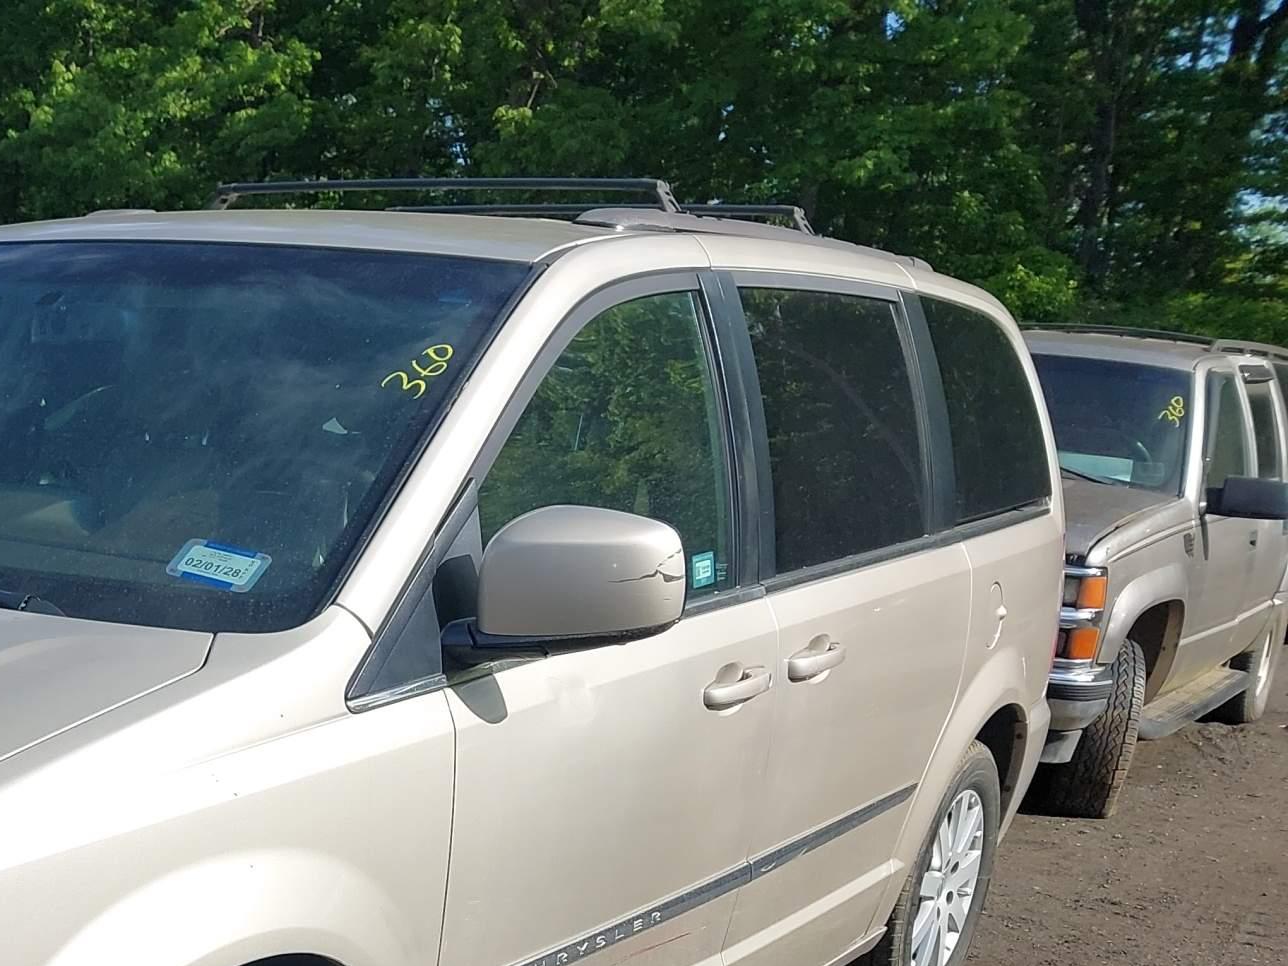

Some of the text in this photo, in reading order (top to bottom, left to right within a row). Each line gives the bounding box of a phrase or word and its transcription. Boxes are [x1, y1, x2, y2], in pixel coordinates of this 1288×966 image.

[380, 344, 454, 400] 360
[1157, 395, 1185, 428] 360
[184, 557, 243, 579] 02/01/28
